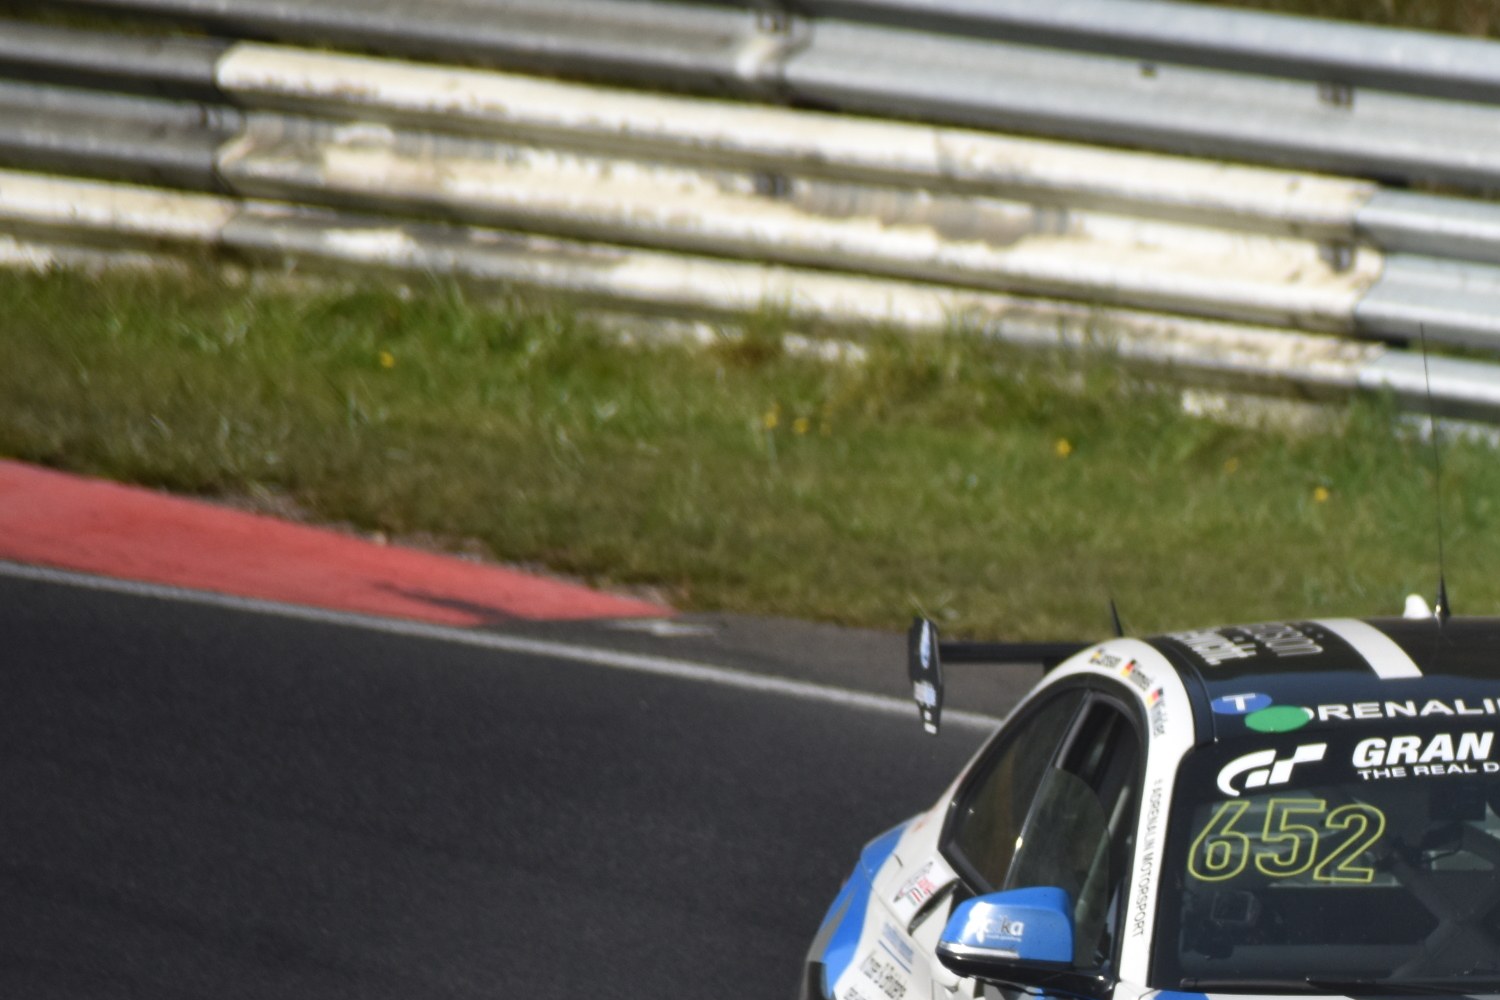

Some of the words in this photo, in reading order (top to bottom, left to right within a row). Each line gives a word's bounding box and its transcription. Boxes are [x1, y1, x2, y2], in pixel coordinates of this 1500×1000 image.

[1352, 732, 1493, 768] GRAN
[1357, 766, 1407, 781] THE
[1413, 763, 1477, 777] REAL
[1187, 799, 1386, 883] 652
